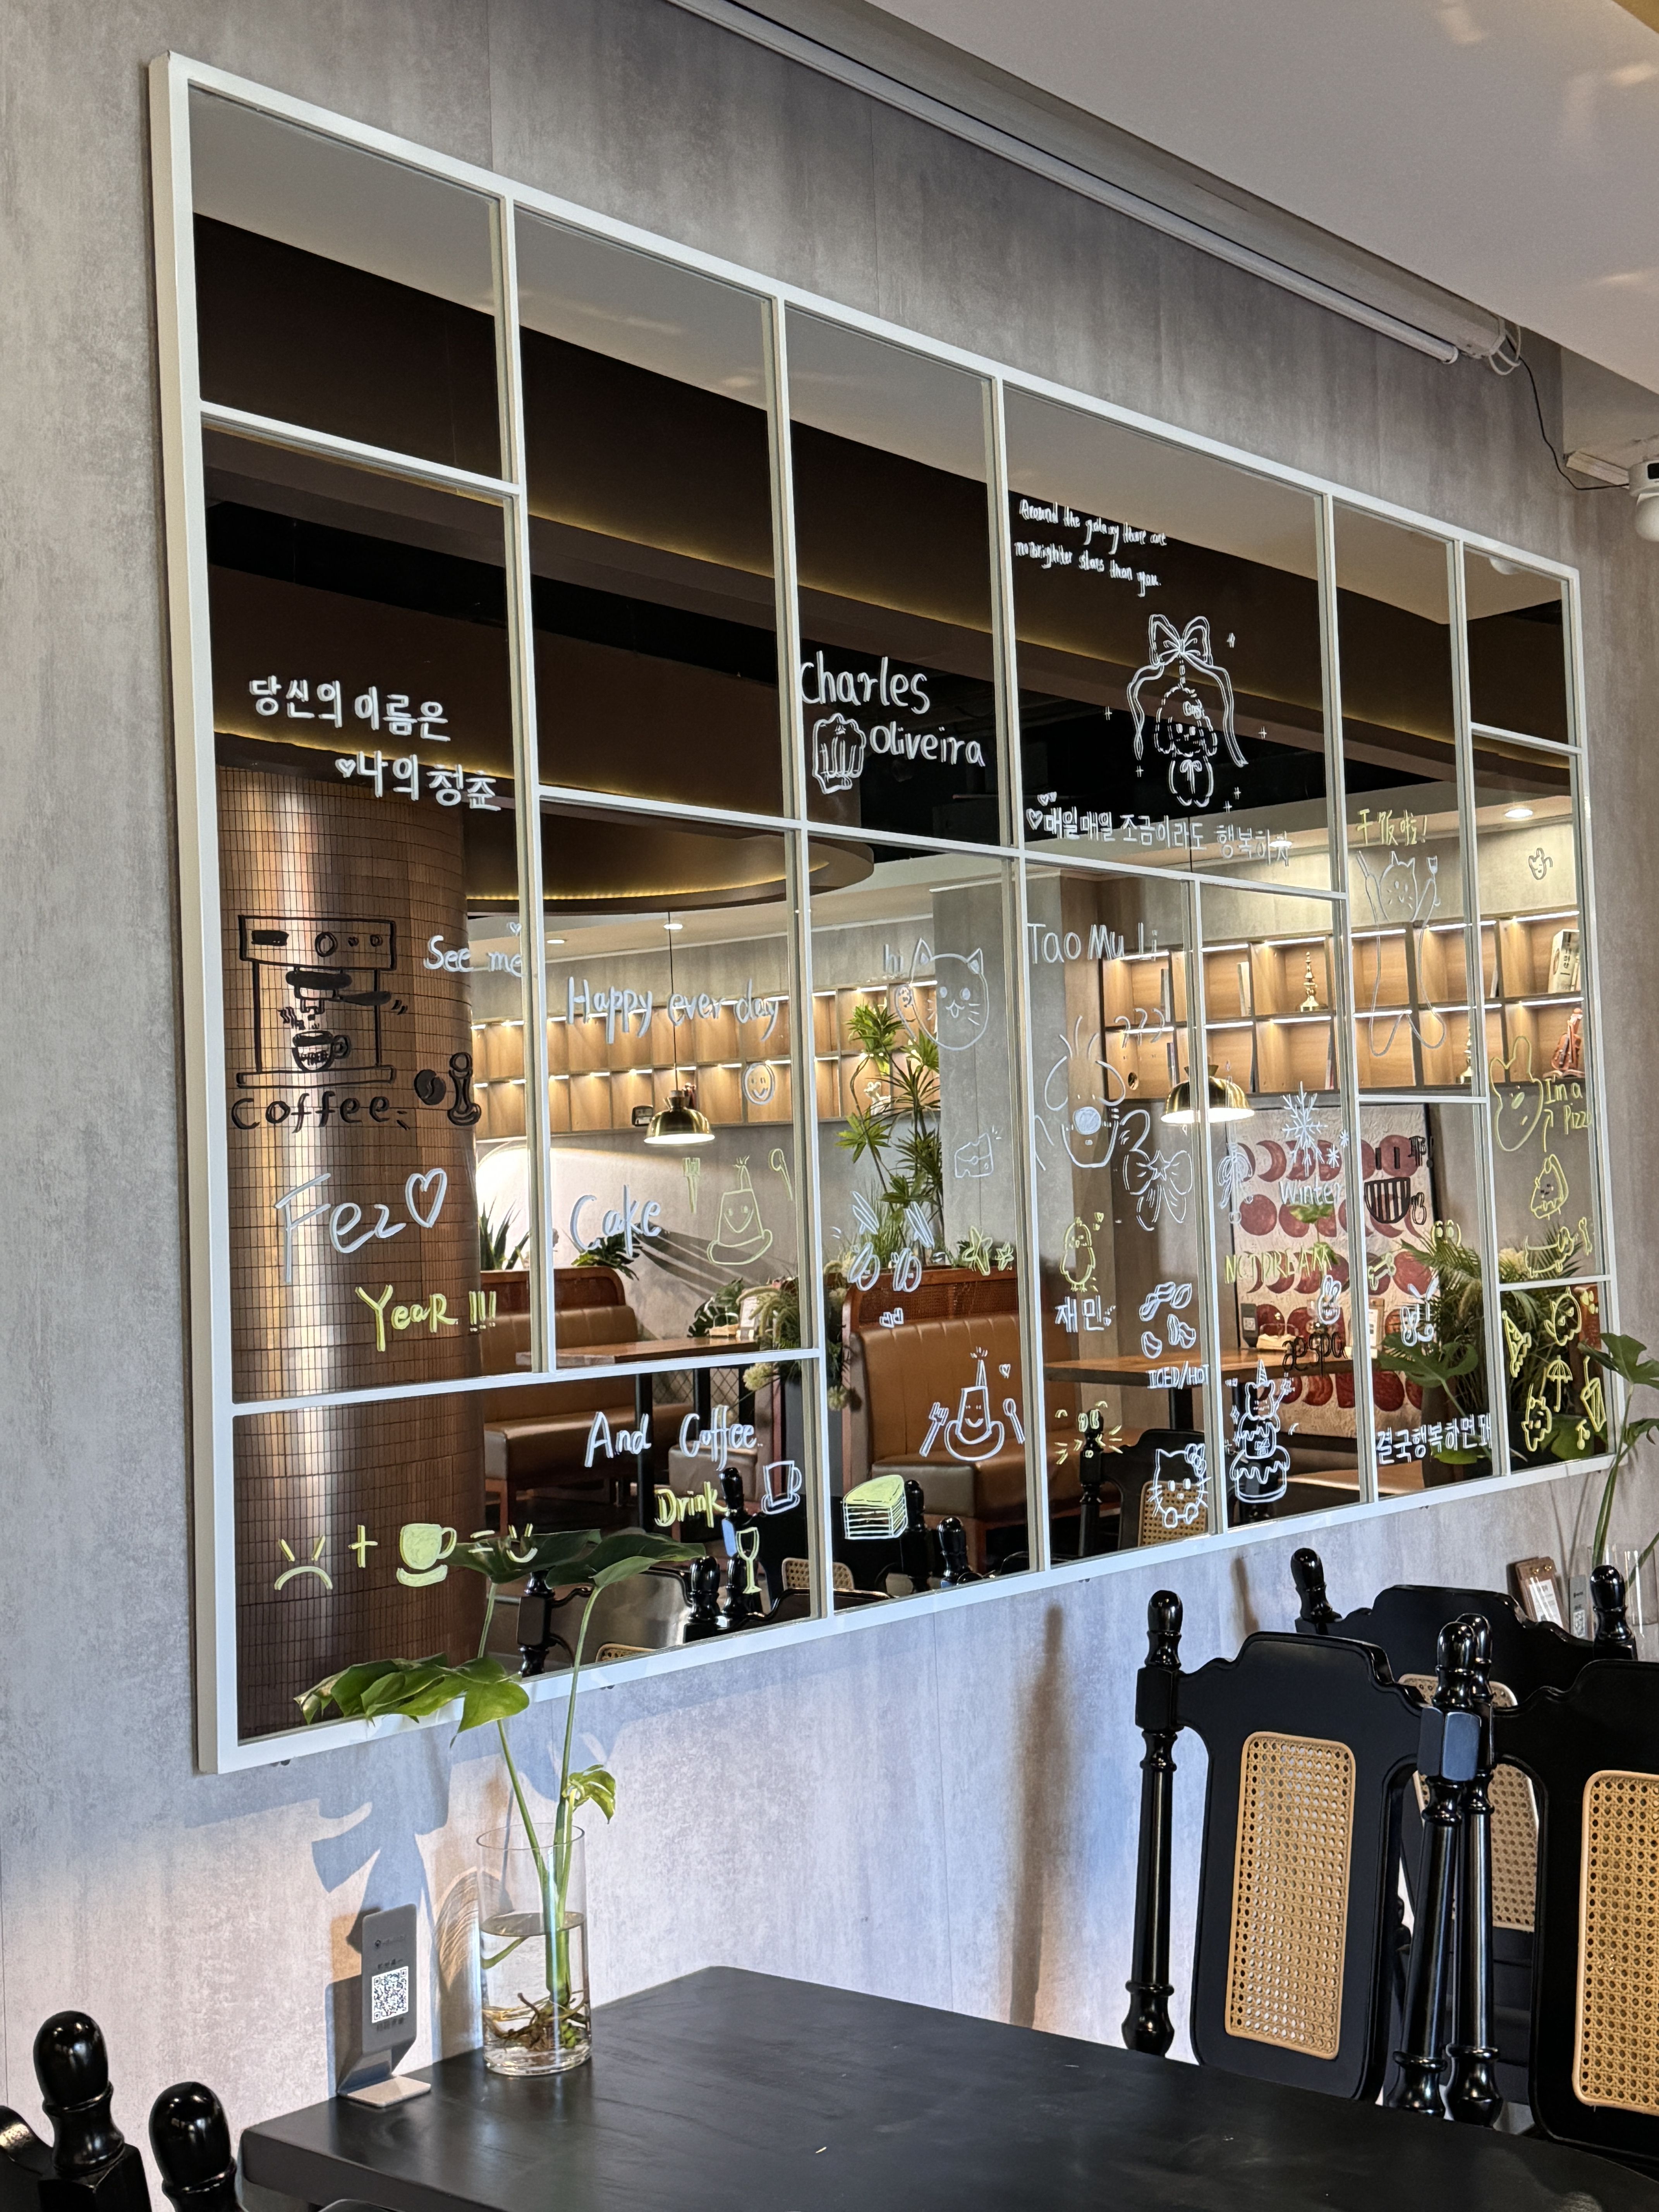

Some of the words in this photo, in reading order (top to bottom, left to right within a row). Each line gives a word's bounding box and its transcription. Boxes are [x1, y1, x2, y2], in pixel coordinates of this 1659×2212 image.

[1063, 506, 1081, 528] the
[1109, 559, 1133, 581] than
[249, 675, 342, 728] 당신의
[354, 686, 451, 742] 이름은
[356, 750, 419, 801] 나의
[426, 764, 501, 811] 청춘
[423, 935, 474, 972] See
[488, 951, 524, 977] me
[1027, 922, 1082, 964] Tao
[567, 976, 653, 1044] Happy
[734, 978, 778, 1042] day
[570, 1184, 662, 1258] Cake
[584, 1411, 652, 1468] And
